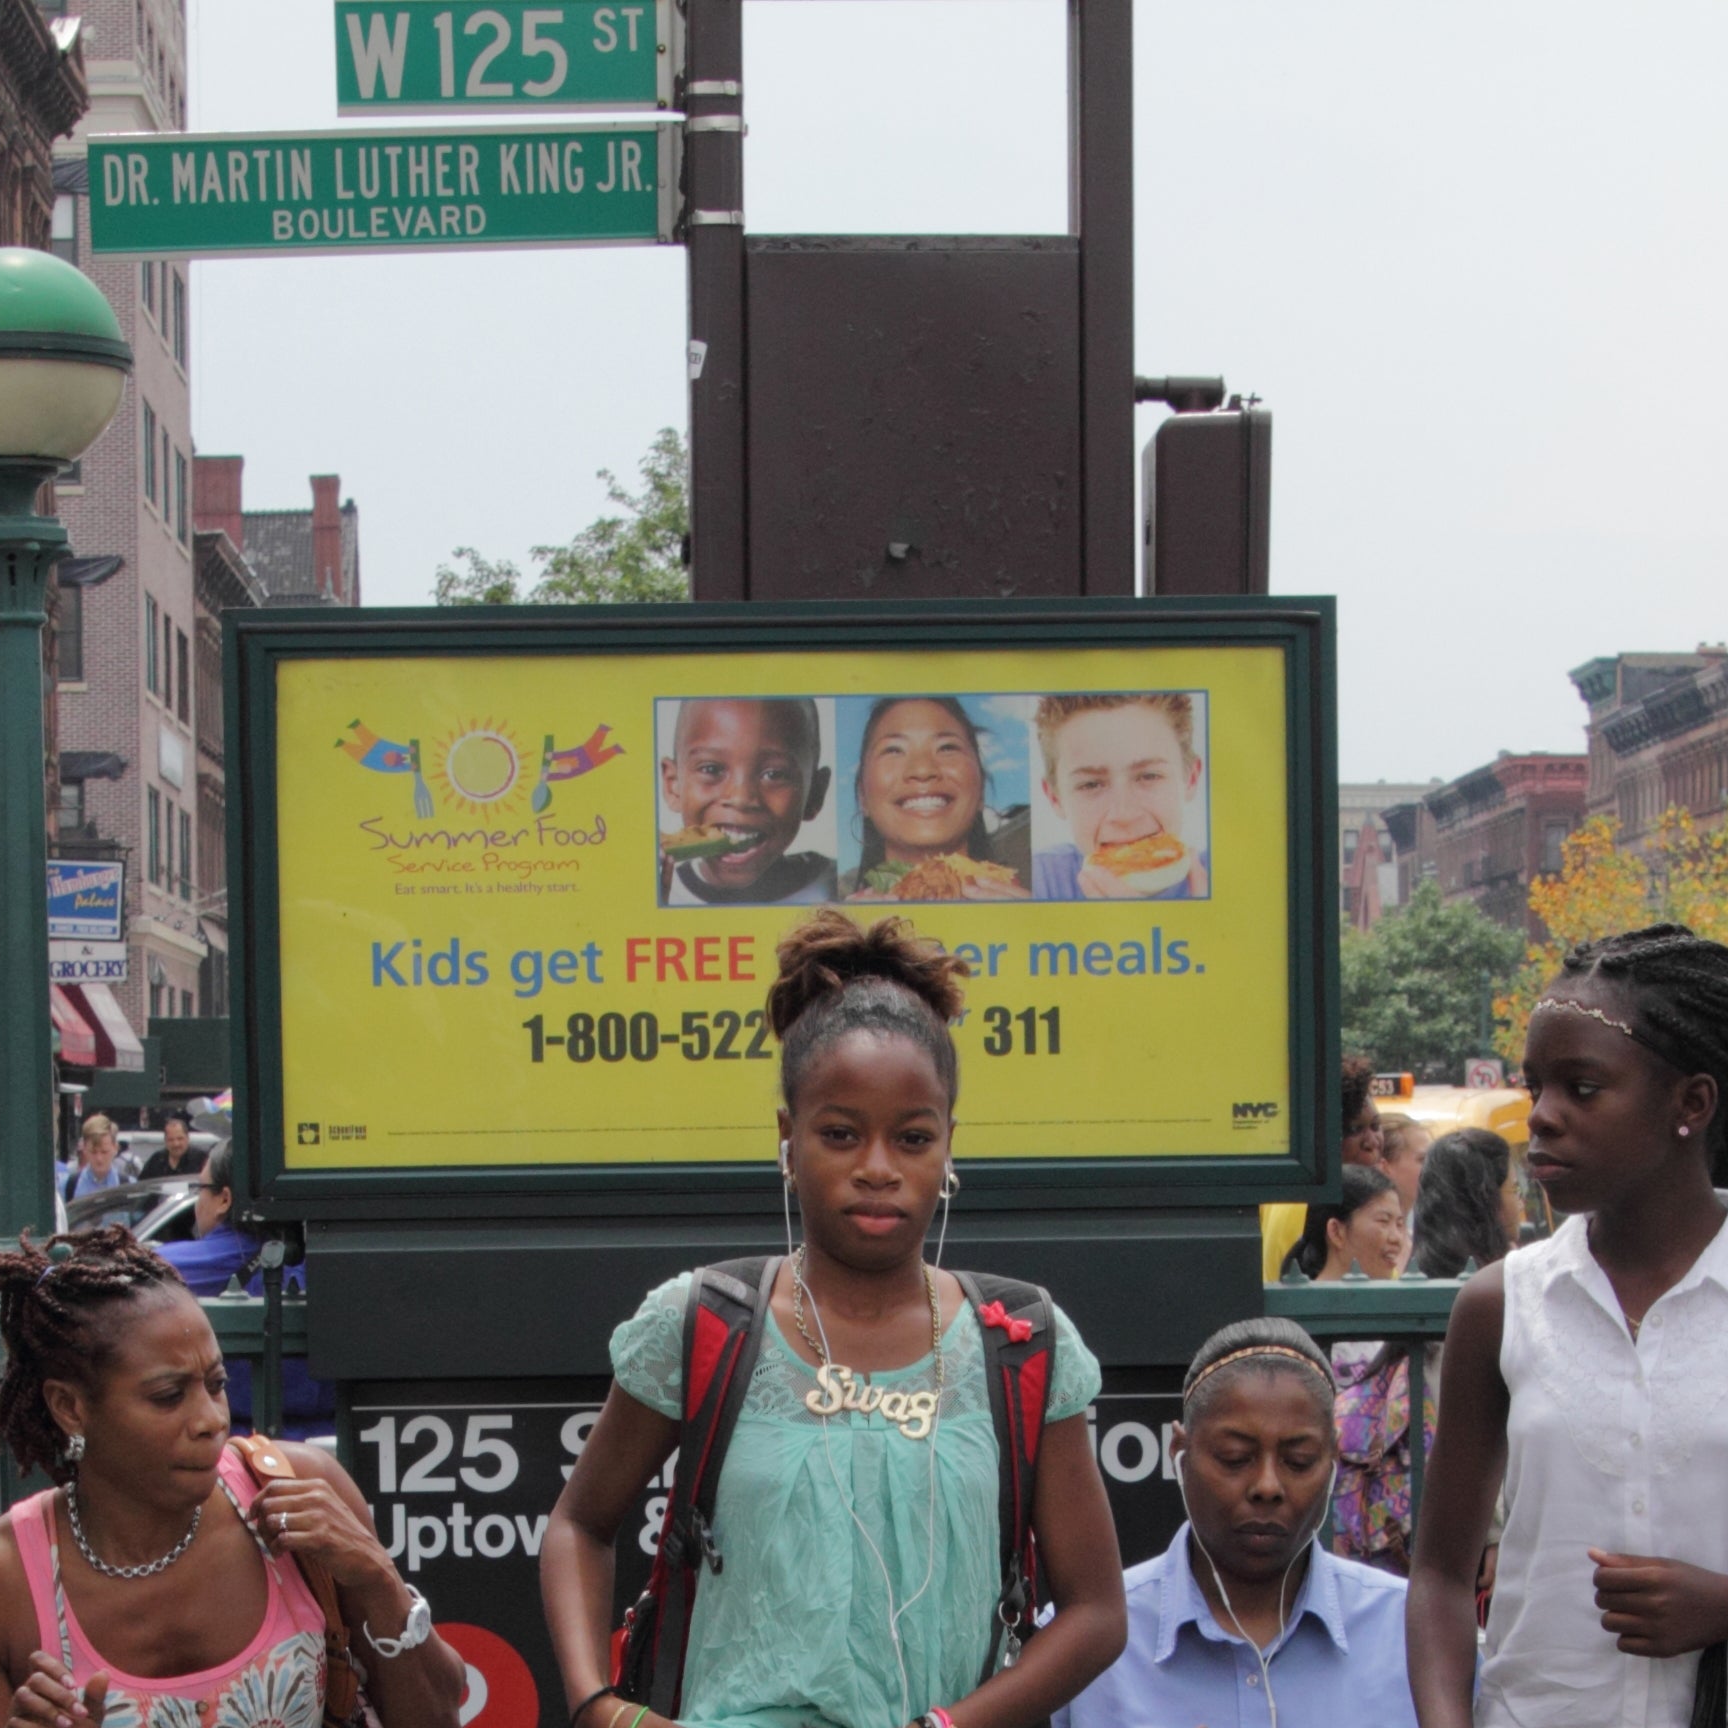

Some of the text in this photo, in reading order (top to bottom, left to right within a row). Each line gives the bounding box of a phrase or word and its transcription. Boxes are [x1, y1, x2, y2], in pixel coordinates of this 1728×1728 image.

[345, 8, 644, 98] W 125 ST
[103, 140, 653, 206] DR. MARTIN LUTHER KING JR.
[272, 204, 487, 240] BOULEVARD
[359, 813, 607, 850] Summer Food
[387, 852, 580, 879] Service Program
[395, 883, 416, 895] Eat
[497, 881, 542, 895] healthy
[50, 960, 124, 978] GROCERY
[371, 937, 490, 987] Kids
[509, 941, 604, 998] get
[626, 936, 756, 983] FREE
[1029, 927, 1206, 977] meals.
[522, 1010, 772, 1063] 1-800-522
[983, 1006, 1061, 1058] 311
[1232, 1102, 1279, 1118] NYC
[806, 1364, 942, 1439] Swag
[360, 1414, 519, 1494] 125
